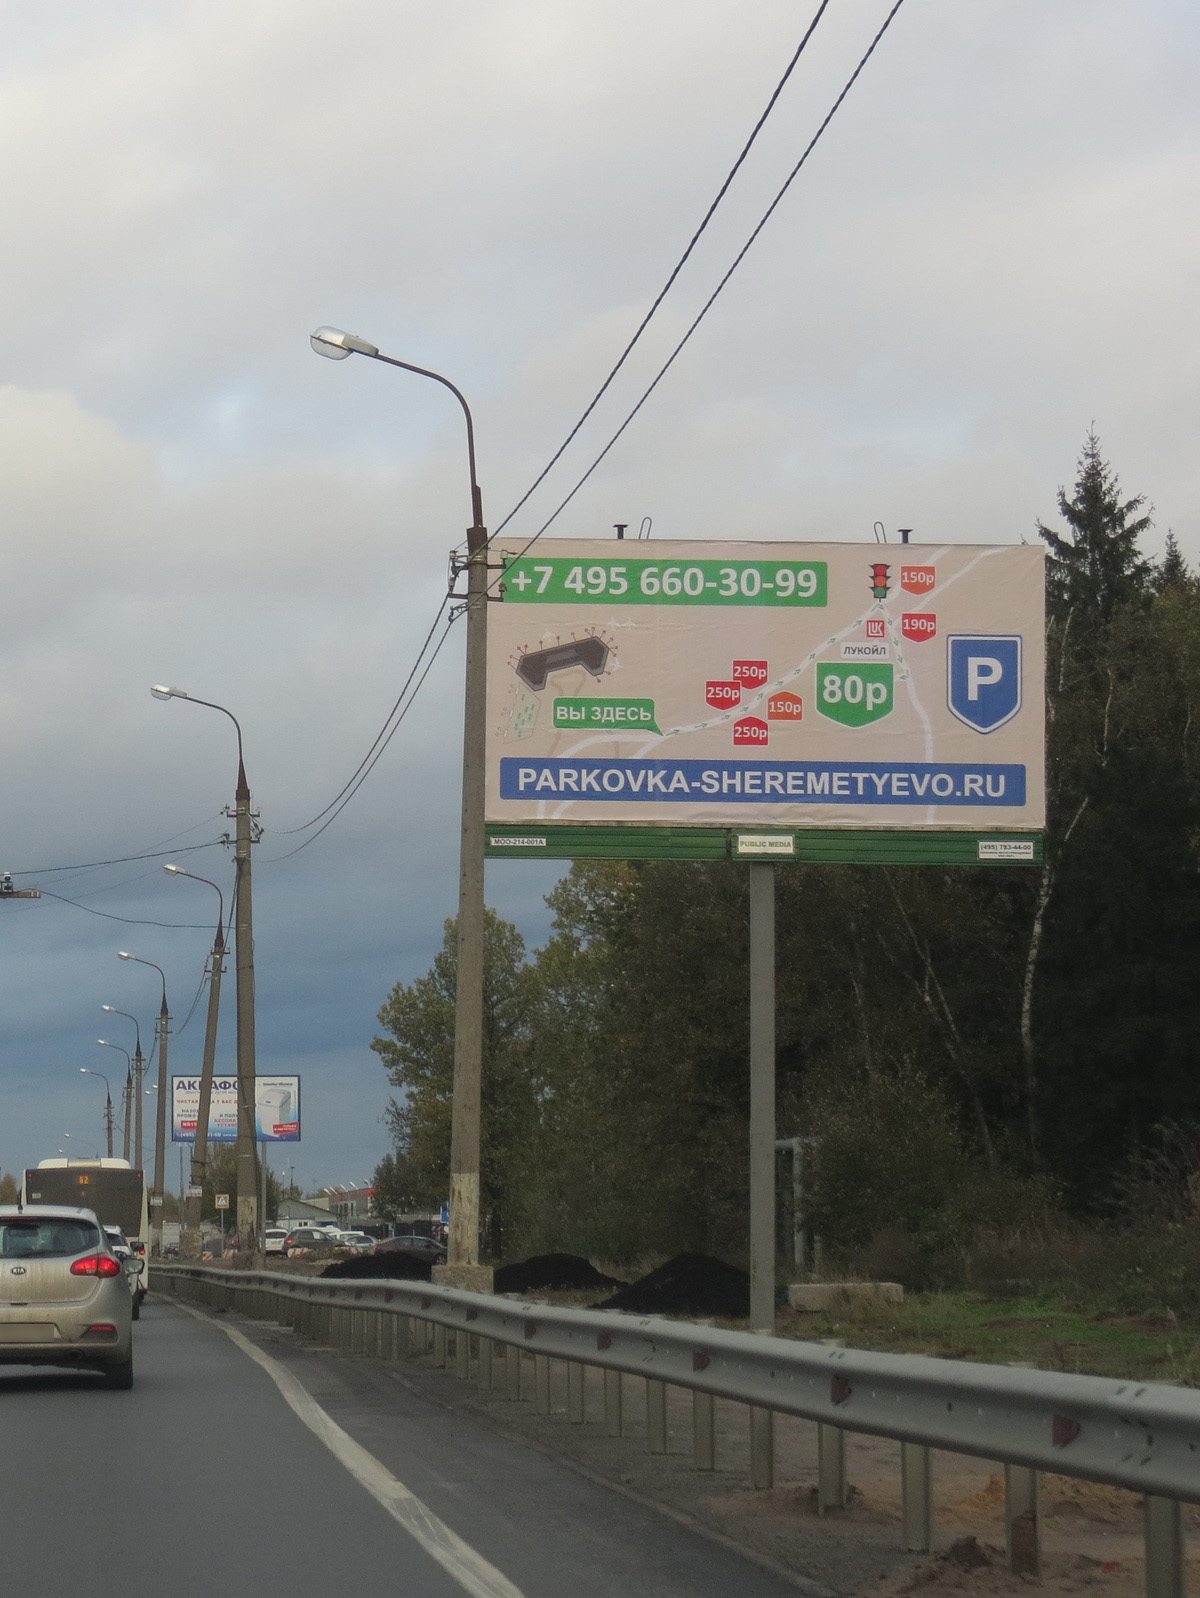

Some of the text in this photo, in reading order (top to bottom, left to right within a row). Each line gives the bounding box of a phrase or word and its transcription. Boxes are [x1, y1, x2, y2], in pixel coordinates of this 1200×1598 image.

[511, 566, 818, 598] +7 495 660-30-99
[902, 572, 934, 586] 150р
[903, 619, 935, 633] 190р
[843, 645, 886, 655] ЛУКОЙЛ
[734, 666, 766, 680] 250р
[967, 656, 1003, 701] P
[707, 687, 740, 701] 250р
[822, 674, 888, 711] 80р
[556, 706, 652, 723] ВЫ ЗДЕСЬ
[769, 701, 802, 715] 150р
[734, 726, 767, 740] 250р
[518, 767, 1006, 798] PARKOVKA-SHEREMETYEVO.RU
[740, 840, 767, 848] PUBLIC
